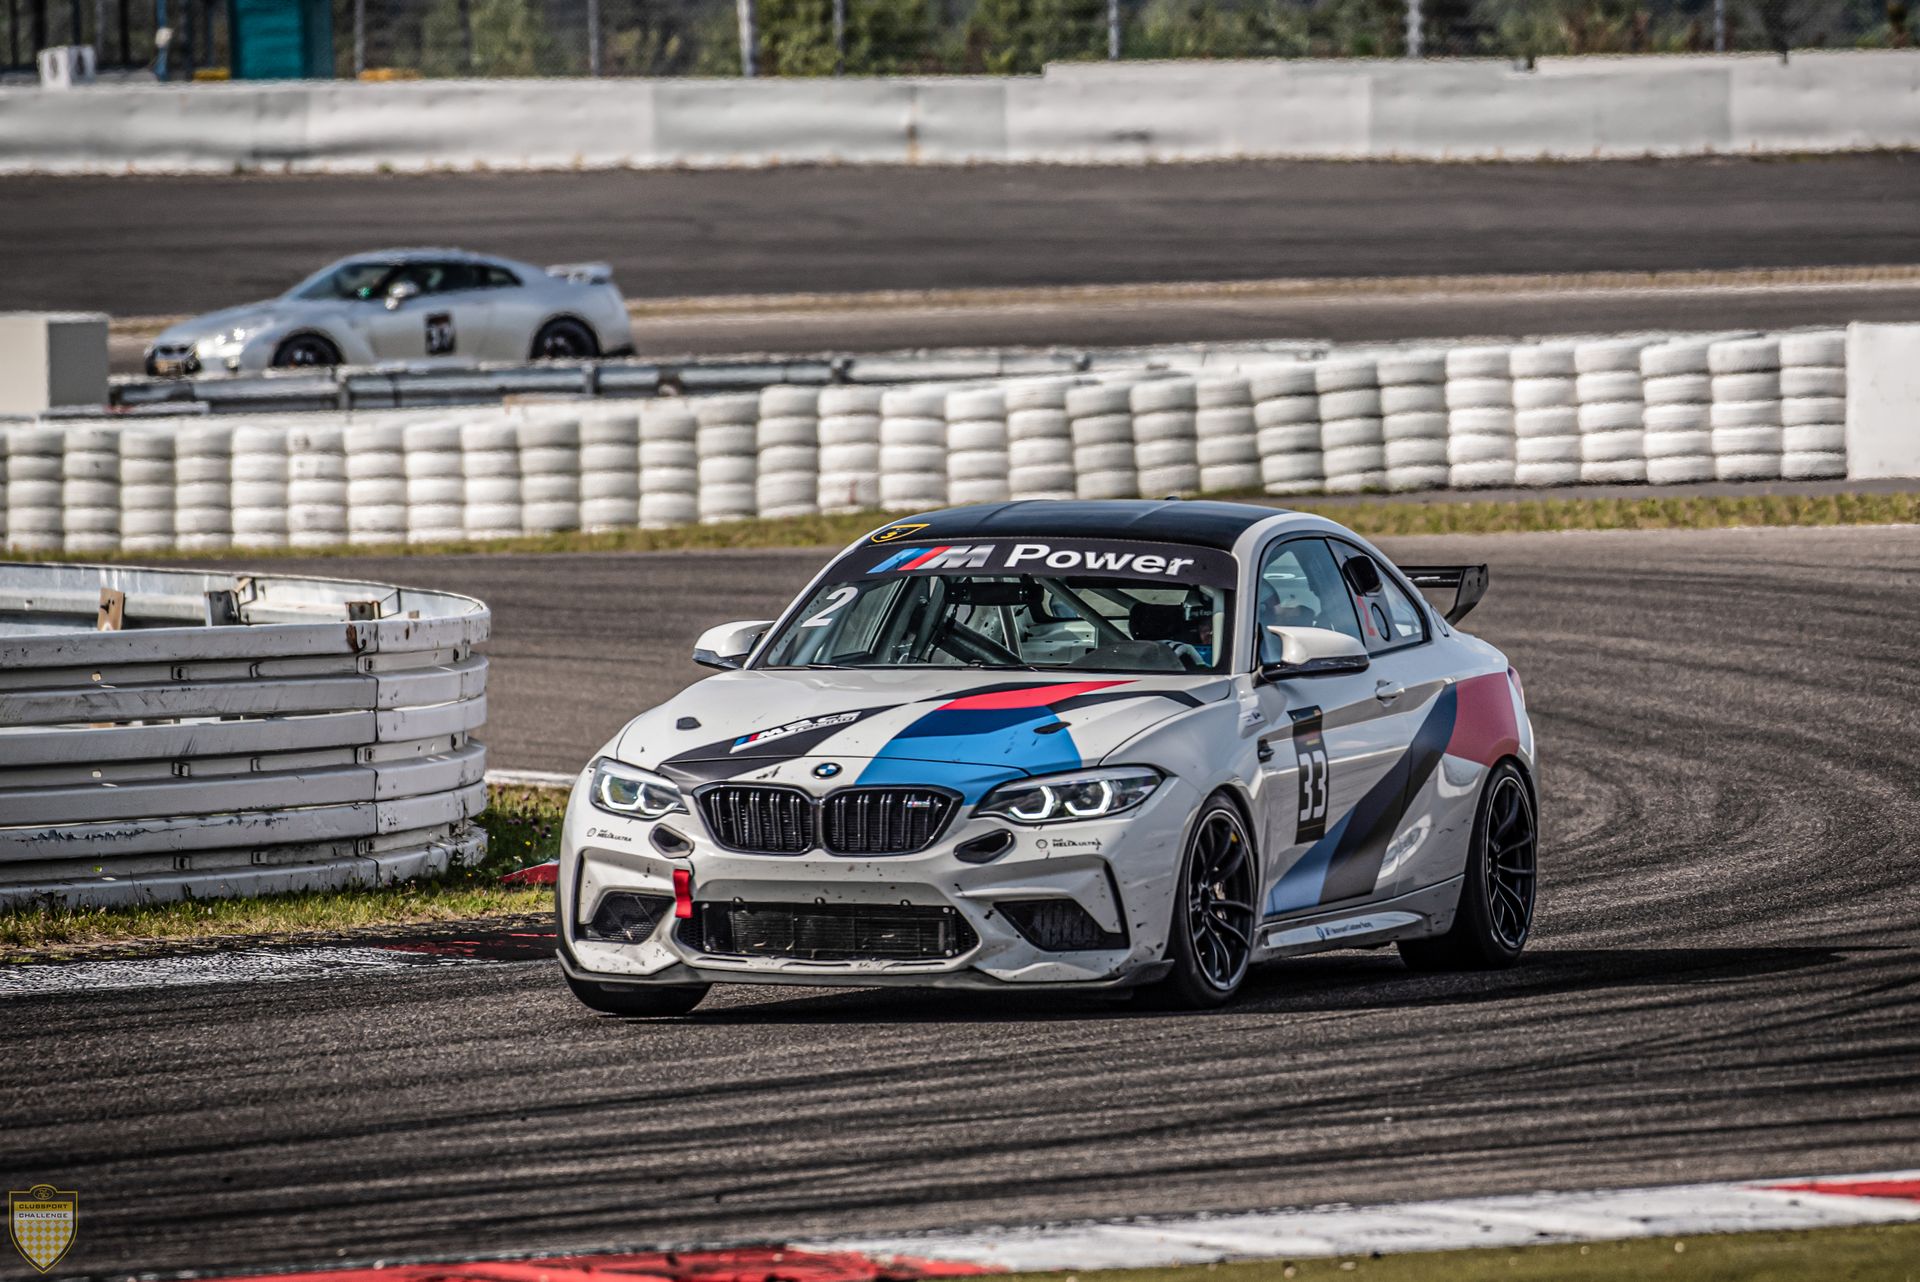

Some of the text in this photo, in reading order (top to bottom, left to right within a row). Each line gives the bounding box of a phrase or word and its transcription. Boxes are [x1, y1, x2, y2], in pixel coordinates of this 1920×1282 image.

[1004, 544, 1194, 576] Power
[801, 586, 858, 628] 2
[1298, 749, 1327, 822] 33
